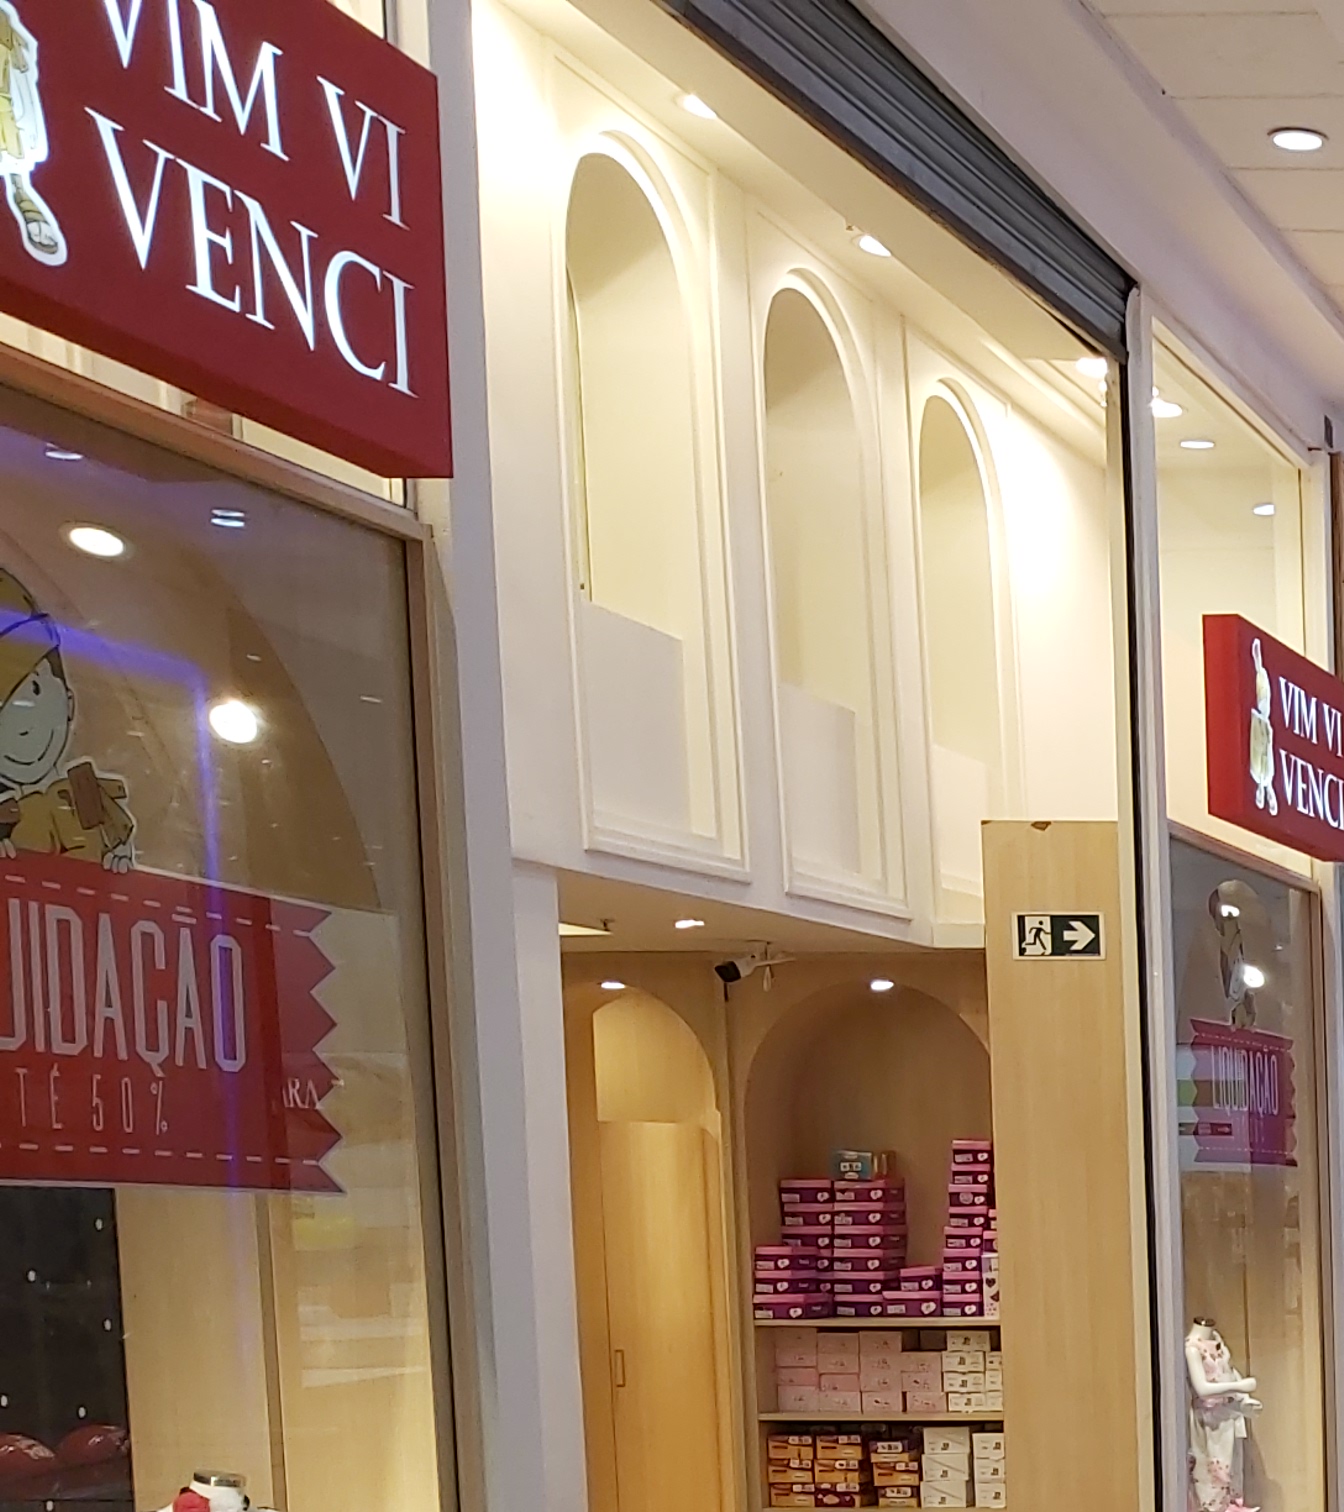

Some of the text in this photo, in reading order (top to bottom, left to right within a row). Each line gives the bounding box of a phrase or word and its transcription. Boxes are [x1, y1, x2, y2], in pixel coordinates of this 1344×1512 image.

[317, 75, 411, 231] VI
[85, 107, 419, 399] VENCI
[1279, 676, 1343, 758] VIM VI
[92, 1073, 169, 1135] 50%
